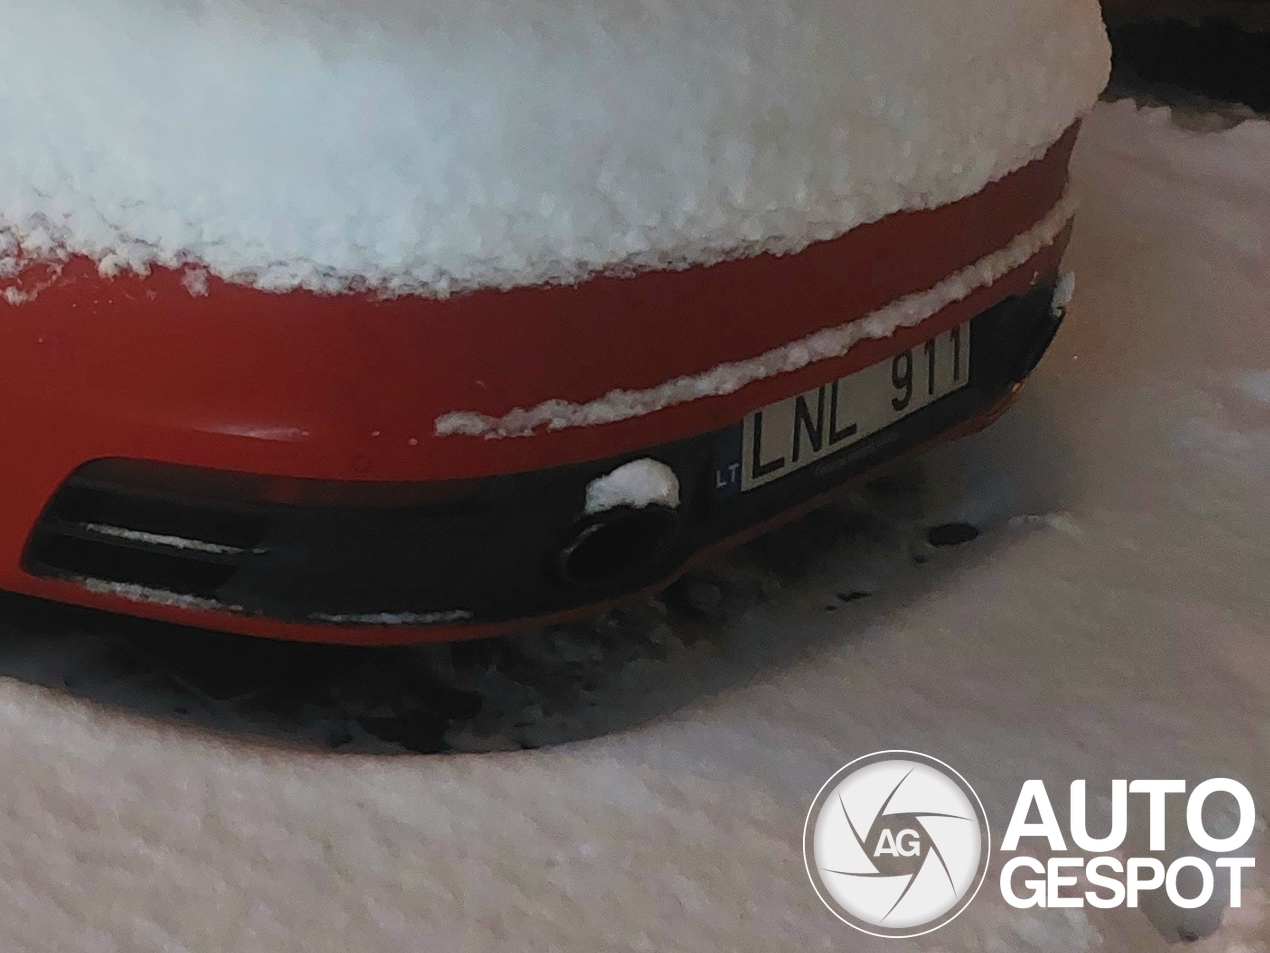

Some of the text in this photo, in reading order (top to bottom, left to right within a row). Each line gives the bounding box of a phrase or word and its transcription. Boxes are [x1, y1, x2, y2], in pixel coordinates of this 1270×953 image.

[751, 379, 857, 478] LNL
[891, 324, 961, 412] 911
[715, 463, 740, 489] LT
